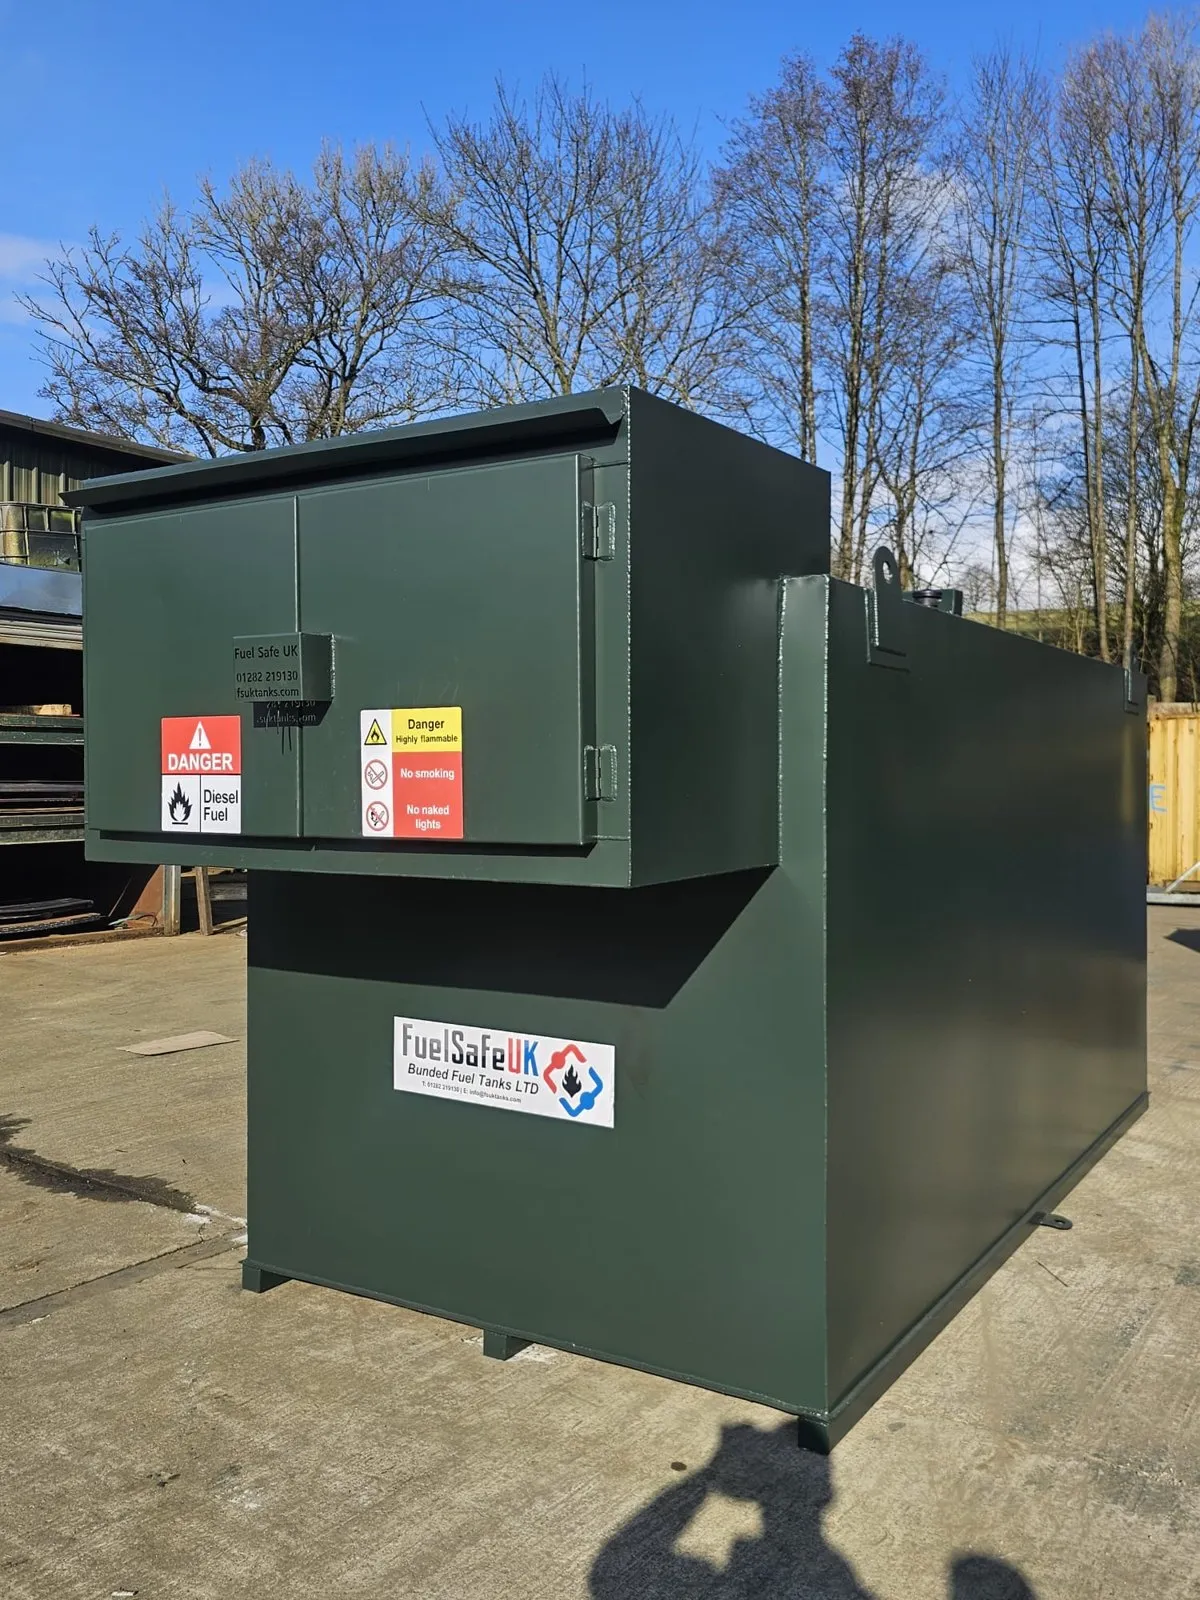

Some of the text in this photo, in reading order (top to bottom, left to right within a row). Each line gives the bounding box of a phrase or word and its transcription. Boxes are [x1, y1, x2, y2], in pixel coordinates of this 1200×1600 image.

[234, 645, 298, 659] Fuel Safe UK
[236, 671, 298, 682] 01282 219130
[236, 687, 299, 698] fsuktanks.com
[408, 719, 445, 731] Danger
[396, 734, 458, 744] Highly flammable
[168, 753, 234, 771] DANGER
[400, 768, 455, 780] No smoking
[203, 789, 239, 804] Diesel
[203, 807, 228, 822] Fuel
[406, 804, 450, 815] No naked
[415, 819, 441, 830] lights
[408, 1063, 539, 1095] Bunded Fuel Tanks LTD
